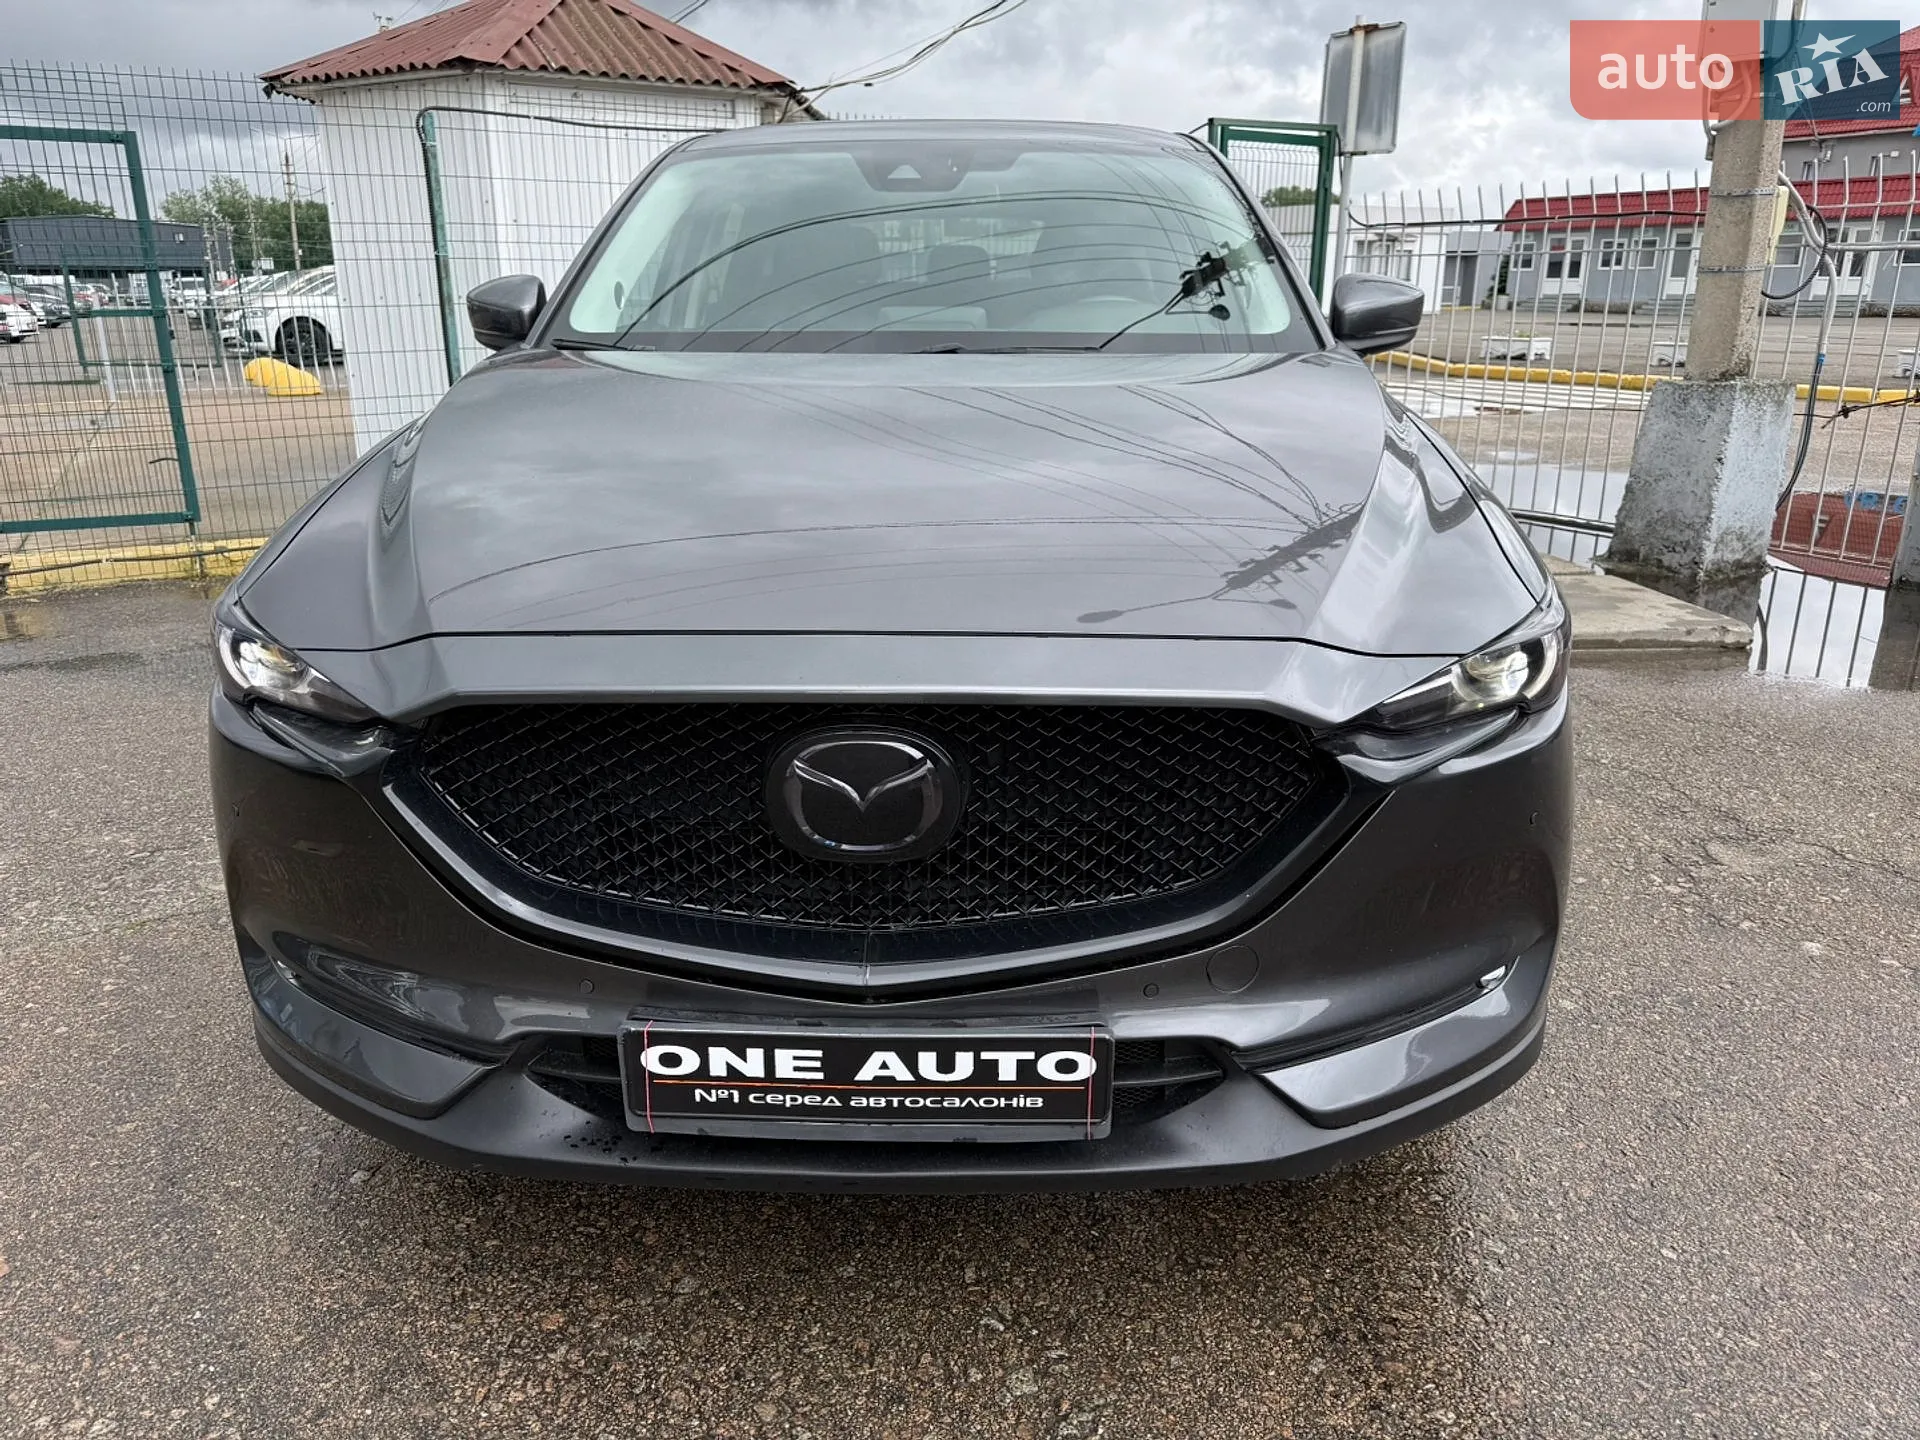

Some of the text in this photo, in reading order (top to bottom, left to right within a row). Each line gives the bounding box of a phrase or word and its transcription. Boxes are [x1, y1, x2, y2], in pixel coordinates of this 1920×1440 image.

[640, 1044, 1097, 1082] ONE AUTO
[694, 1088, 1043, 1108] №1 серед автосалонів
